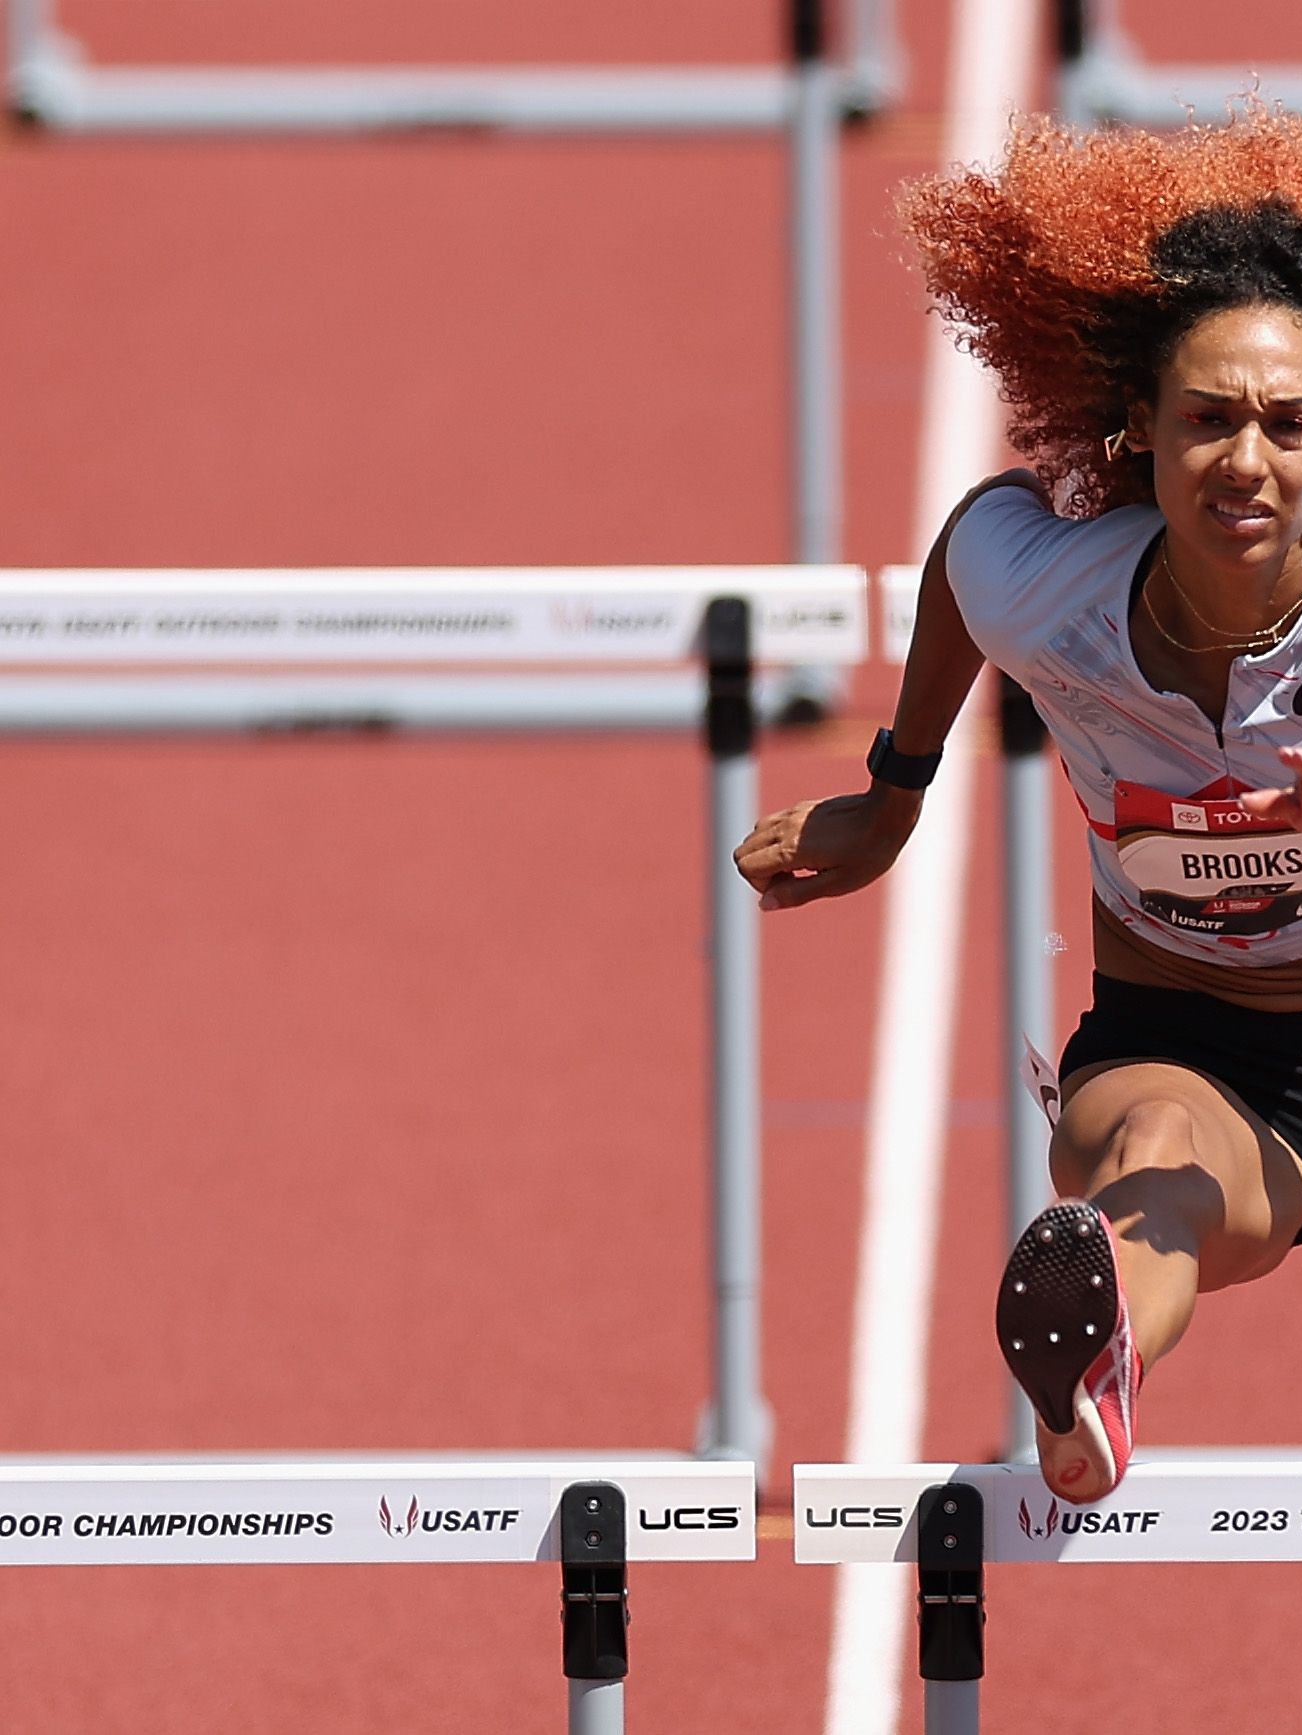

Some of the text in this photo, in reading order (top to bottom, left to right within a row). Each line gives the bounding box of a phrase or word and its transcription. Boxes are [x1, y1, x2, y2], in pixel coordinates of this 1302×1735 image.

[1177, 915, 1225, 931] USATF
[73, 1513, 333, 1537] CHAMPIONSHIPS
[421, 1509, 520, 1532] USATF
[639, 1507, 741, 1530] UCS
[806, 1507, 903, 1528] UCS
[1060, 1511, 1160, 1535] USATF
[1211, 1510, 1289, 1532] 2023
